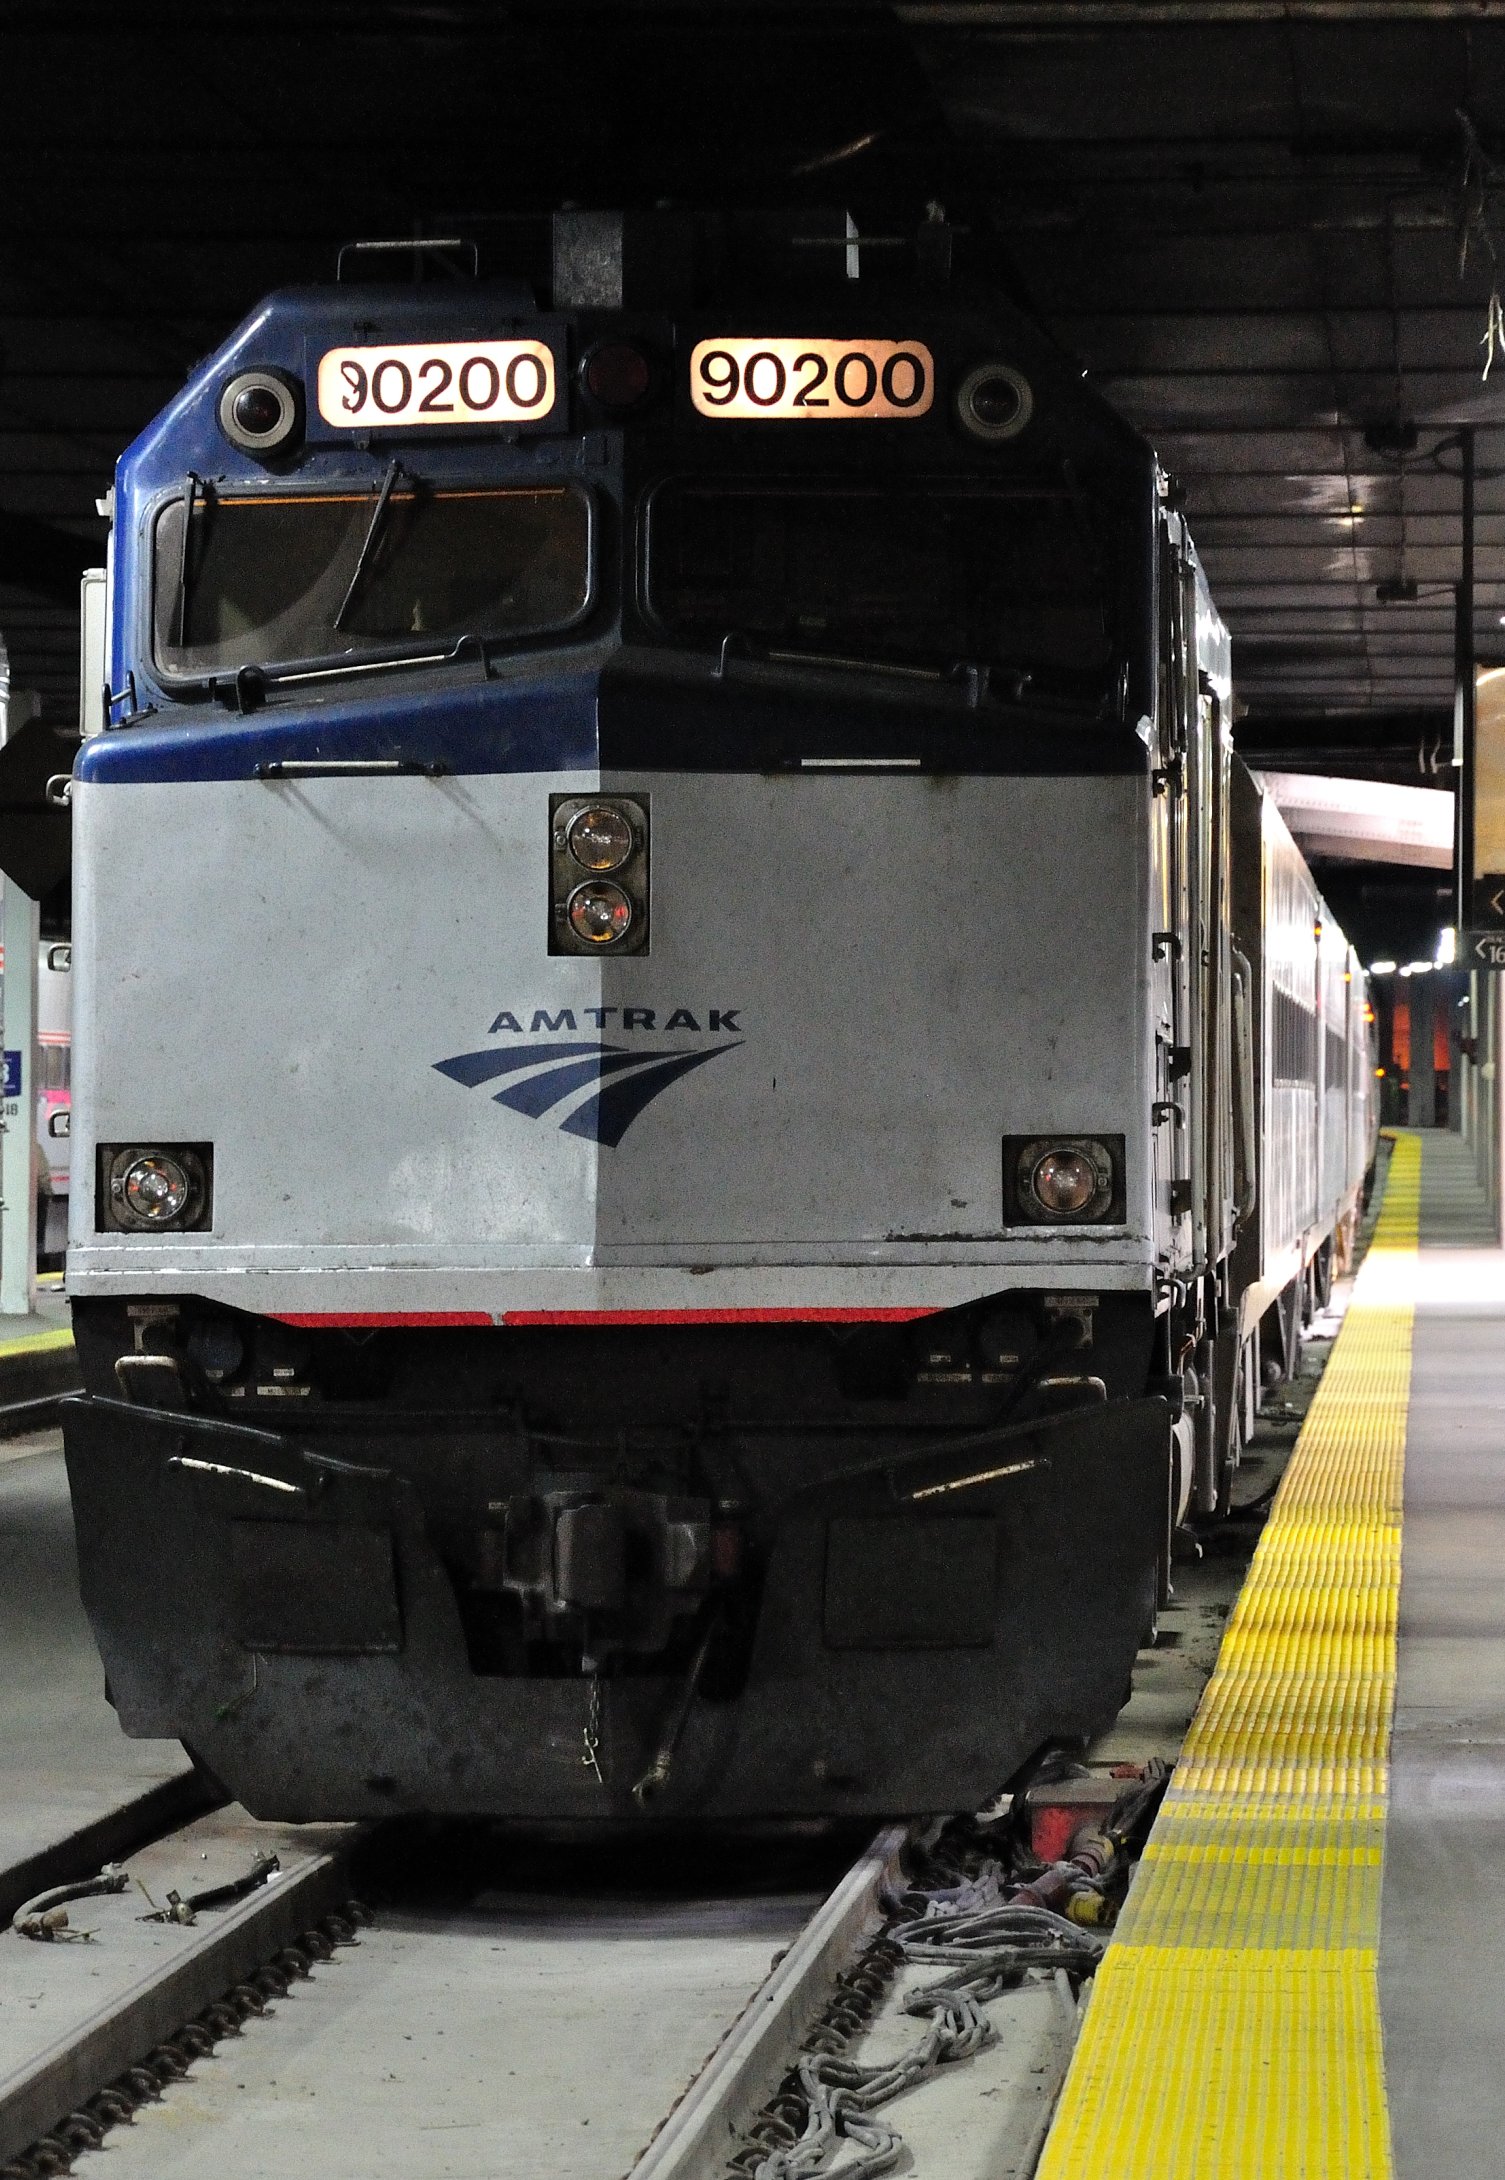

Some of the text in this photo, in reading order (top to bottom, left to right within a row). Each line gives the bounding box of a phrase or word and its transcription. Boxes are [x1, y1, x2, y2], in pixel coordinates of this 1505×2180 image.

[340, 353, 547, 414] 90200
[699, 350, 926, 407] 90200
[487, 1007, 742, 1034] AMTRAK
